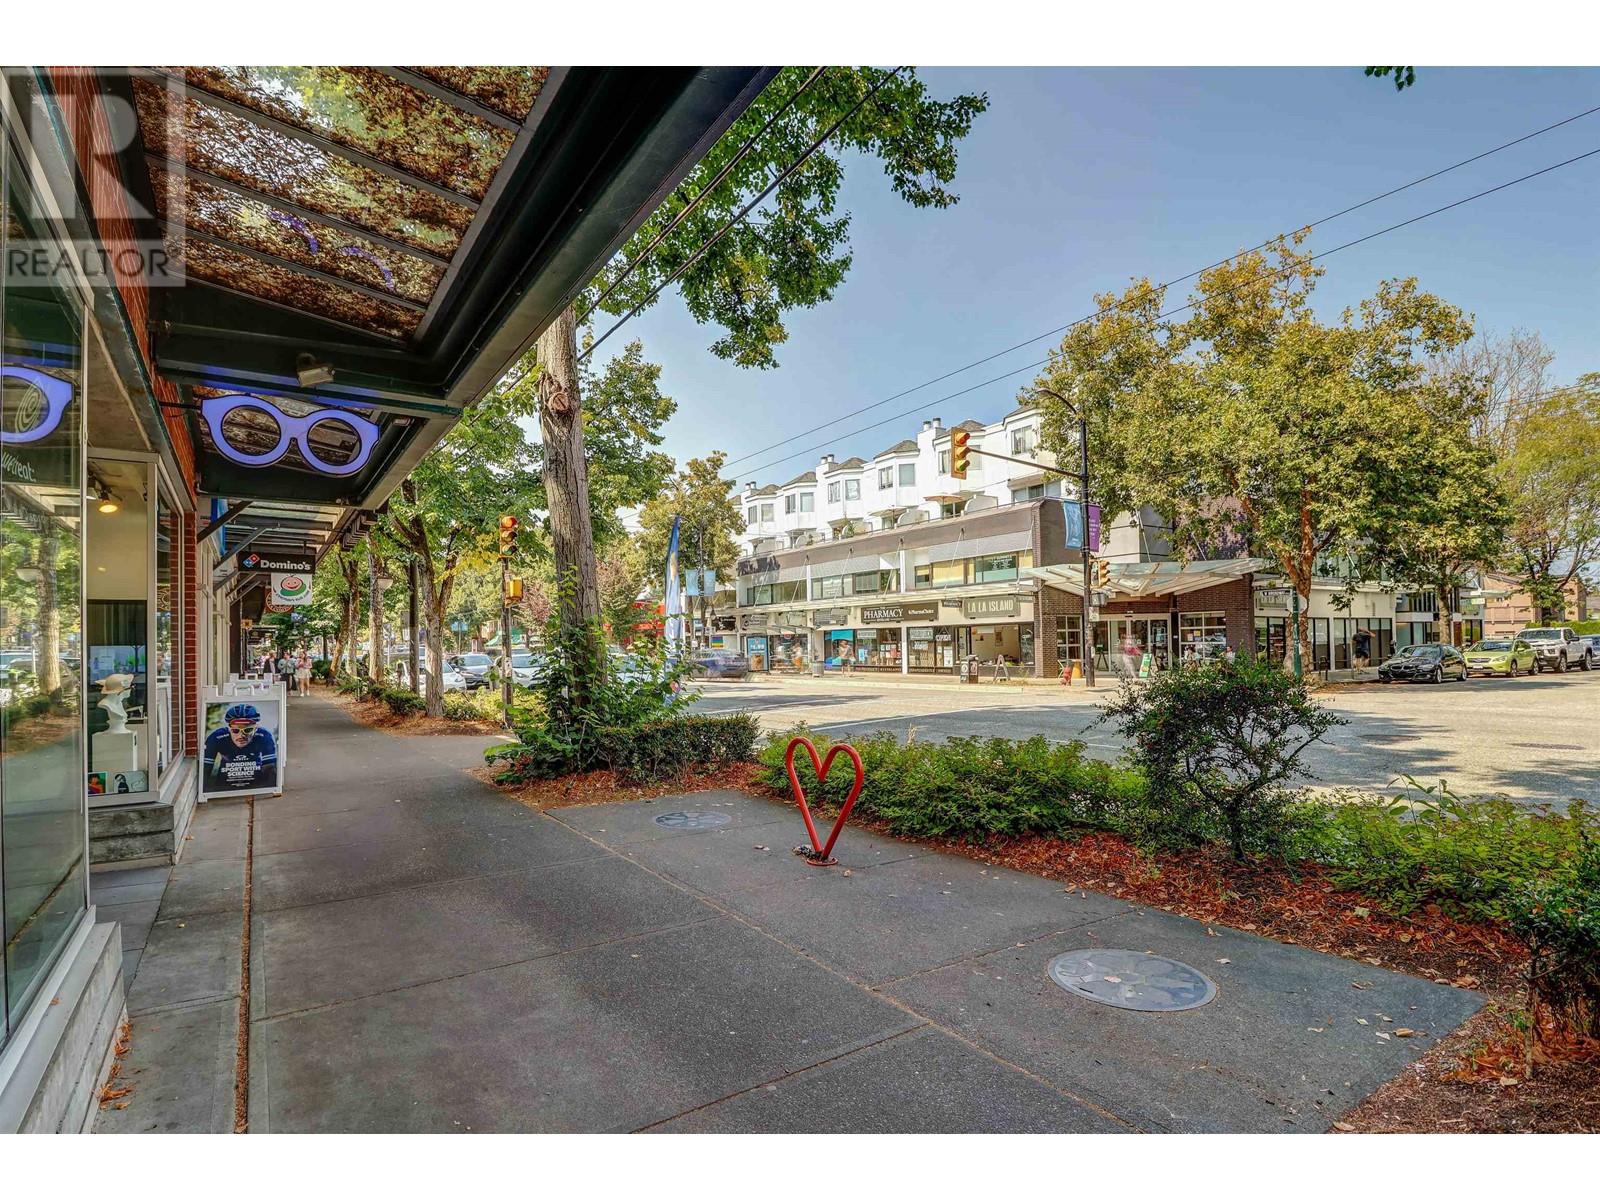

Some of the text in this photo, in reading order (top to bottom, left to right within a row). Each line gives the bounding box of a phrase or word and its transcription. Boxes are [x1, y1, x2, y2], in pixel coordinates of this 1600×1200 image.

[260, 559, 312, 571] Domino's
[967, 602, 976, 613] LA
[978, 601, 987, 612] LA
[988, 600, 1014, 612] ISLAND
[863, 608, 904, 620] PHARMACY
